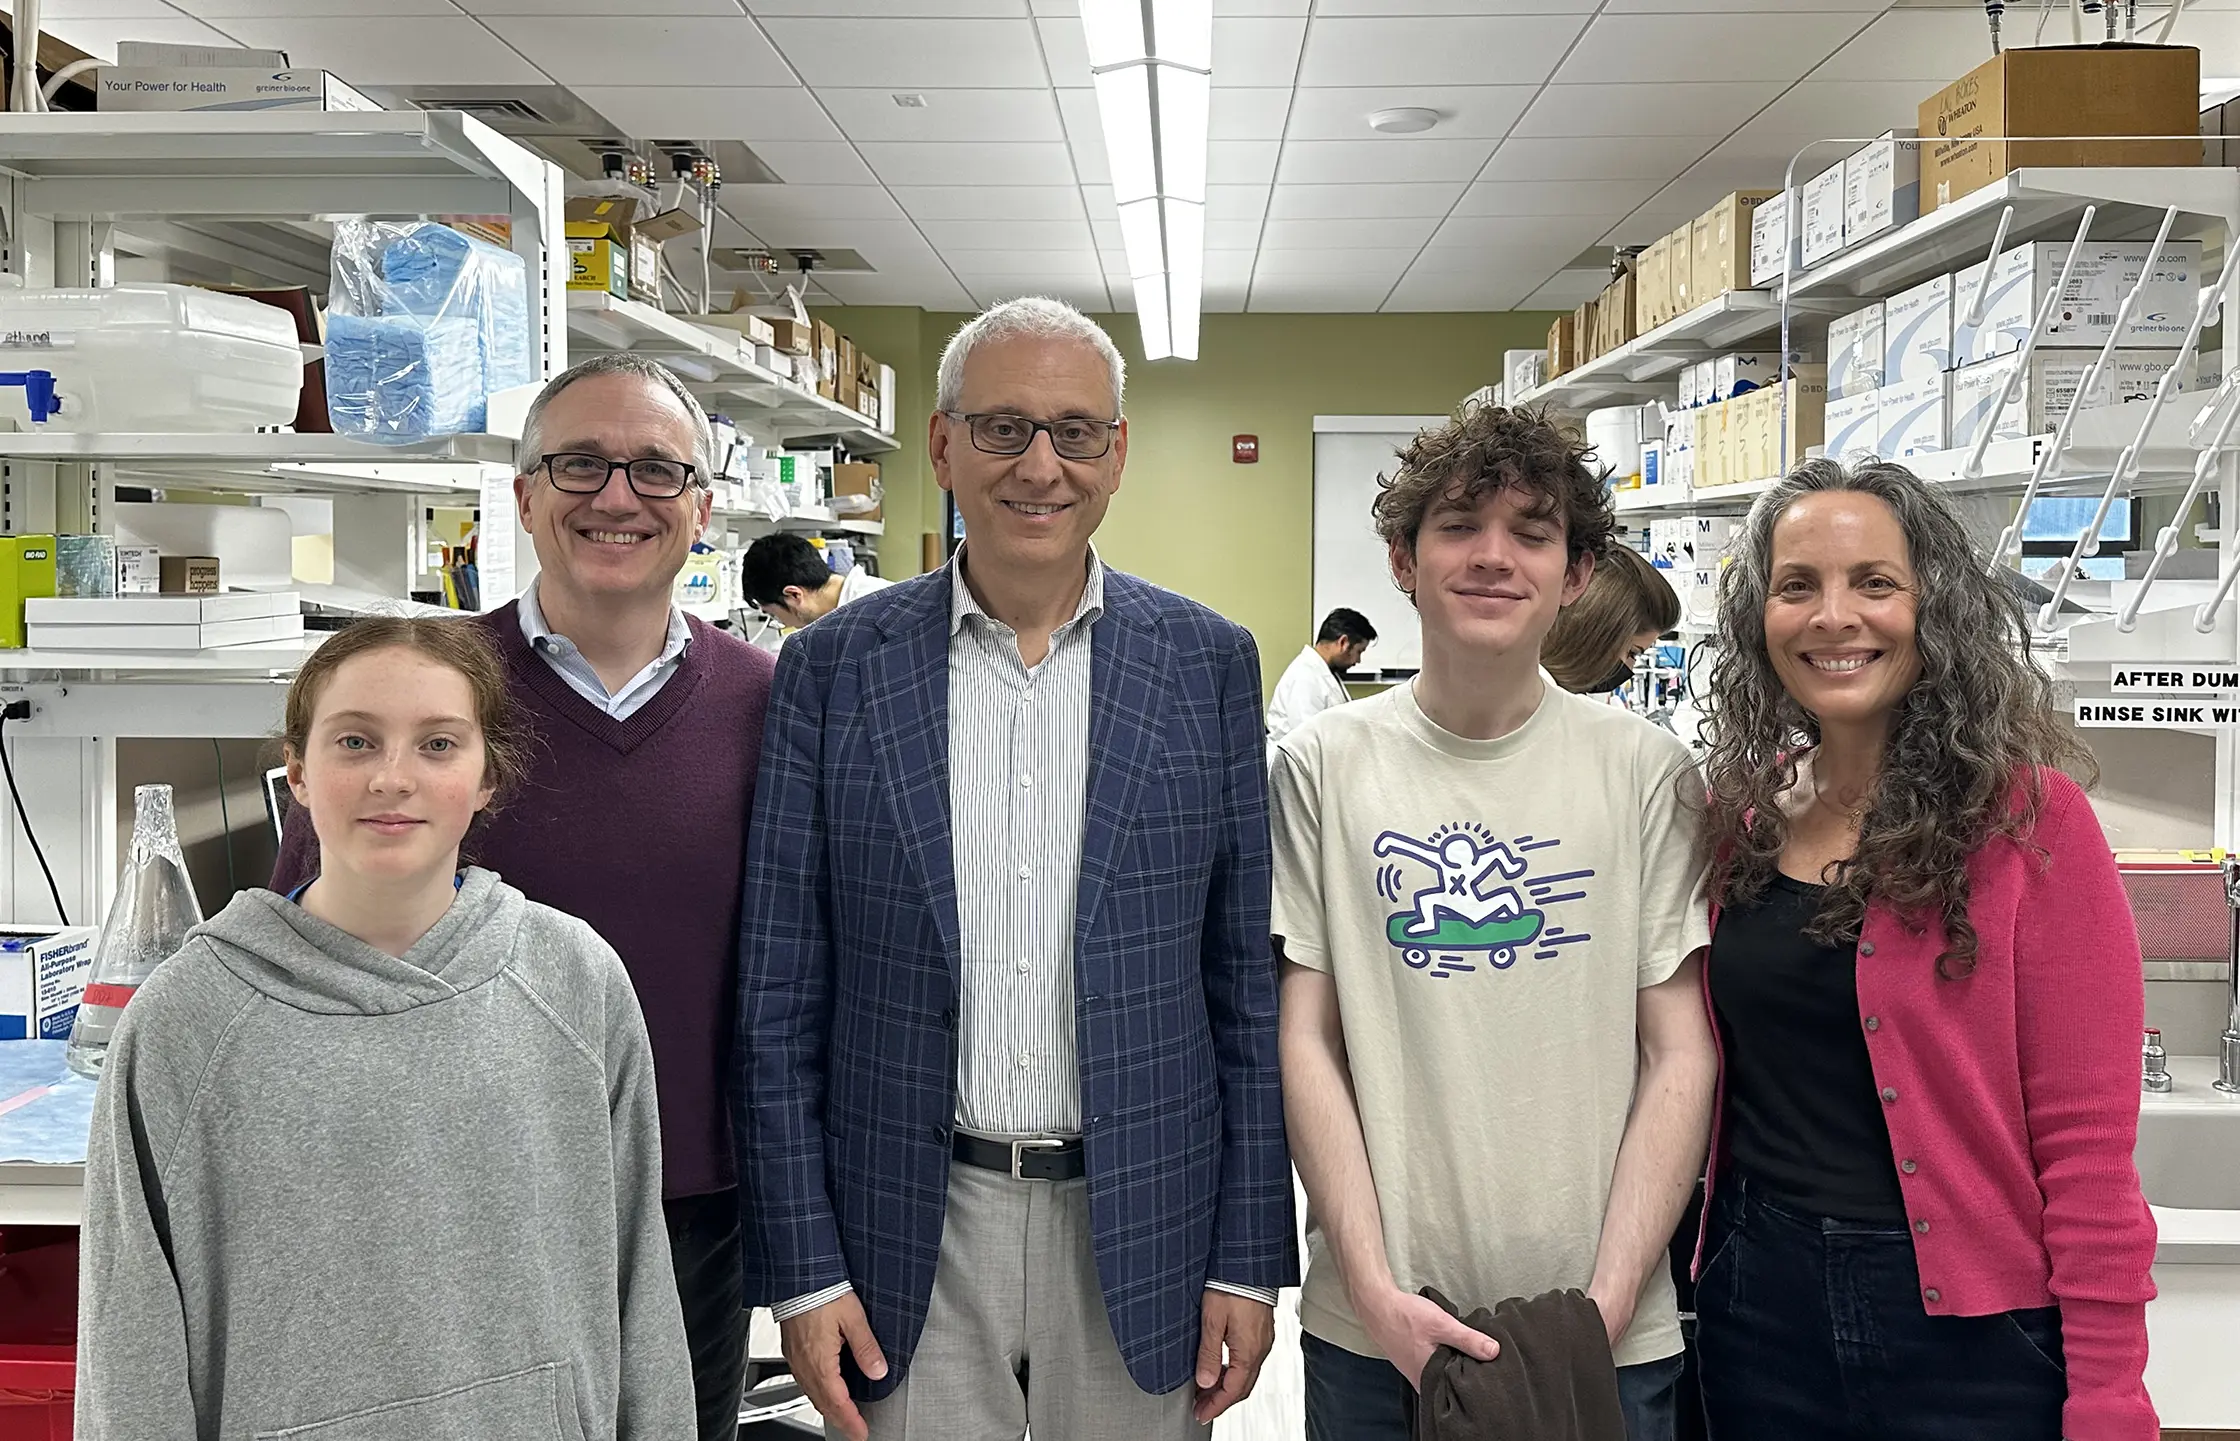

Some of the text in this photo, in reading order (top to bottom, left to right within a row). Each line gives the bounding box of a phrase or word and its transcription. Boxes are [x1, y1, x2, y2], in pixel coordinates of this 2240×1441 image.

[105, 80, 226, 92] Your Power for Health
[256, 85, 283, 93] greiner
[1947, 100, 1977, 123] WHEATON
[5, 331, 50, 344] ethanol
[1810, 385, 1823, 393] BD
[2033, 441, 2042, 465] F
[1699, 520, 1710, 533] M
[25, 551, 47, 559] BIO-RAD
[190, 565, 217, 579] progress
[189, 578, 218, 592] happens
[2114, 671, 2239, 688] AFTER DUM
[2079, 706, 2144, 721] RINSE
[2152, 707, 2204, 722] SINK
[40, 942, 88, 963] FISHERbrand
[40, 955, 76, 972] All-Purpose
[40, 958, 92, 981] Laboratory Wrap
